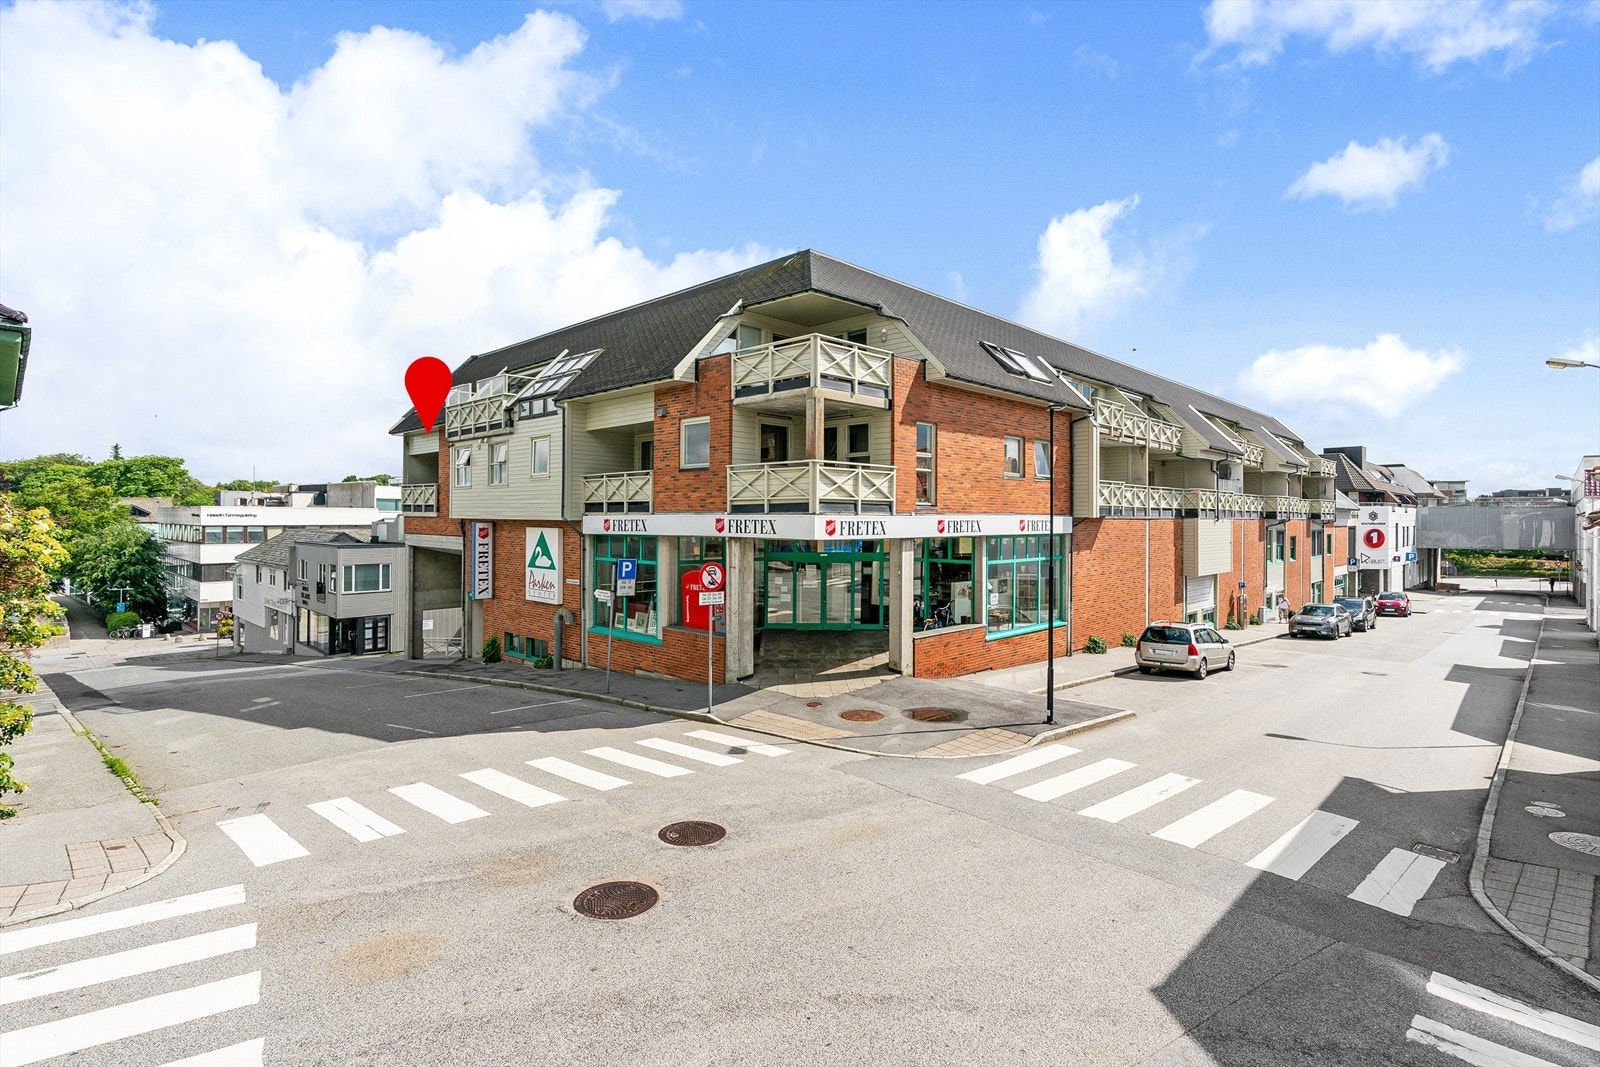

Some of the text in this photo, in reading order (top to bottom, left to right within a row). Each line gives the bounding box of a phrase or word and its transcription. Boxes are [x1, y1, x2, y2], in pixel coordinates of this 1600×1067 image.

[612, 518, 647, 532] FRETEX
[728, 519, 777, 534] FRETEX
[840, 520, 886, 536] FRETEX
[947, 520, 982, 534] FRETEX
[1027, 520, 1050, 532] FRETE
[1370, 532, 1378, 544] 1
[478, 542, 490, 595] FRETEX
[622, 561, 632, 578] P
[528, 570, 556, 590] Parken
